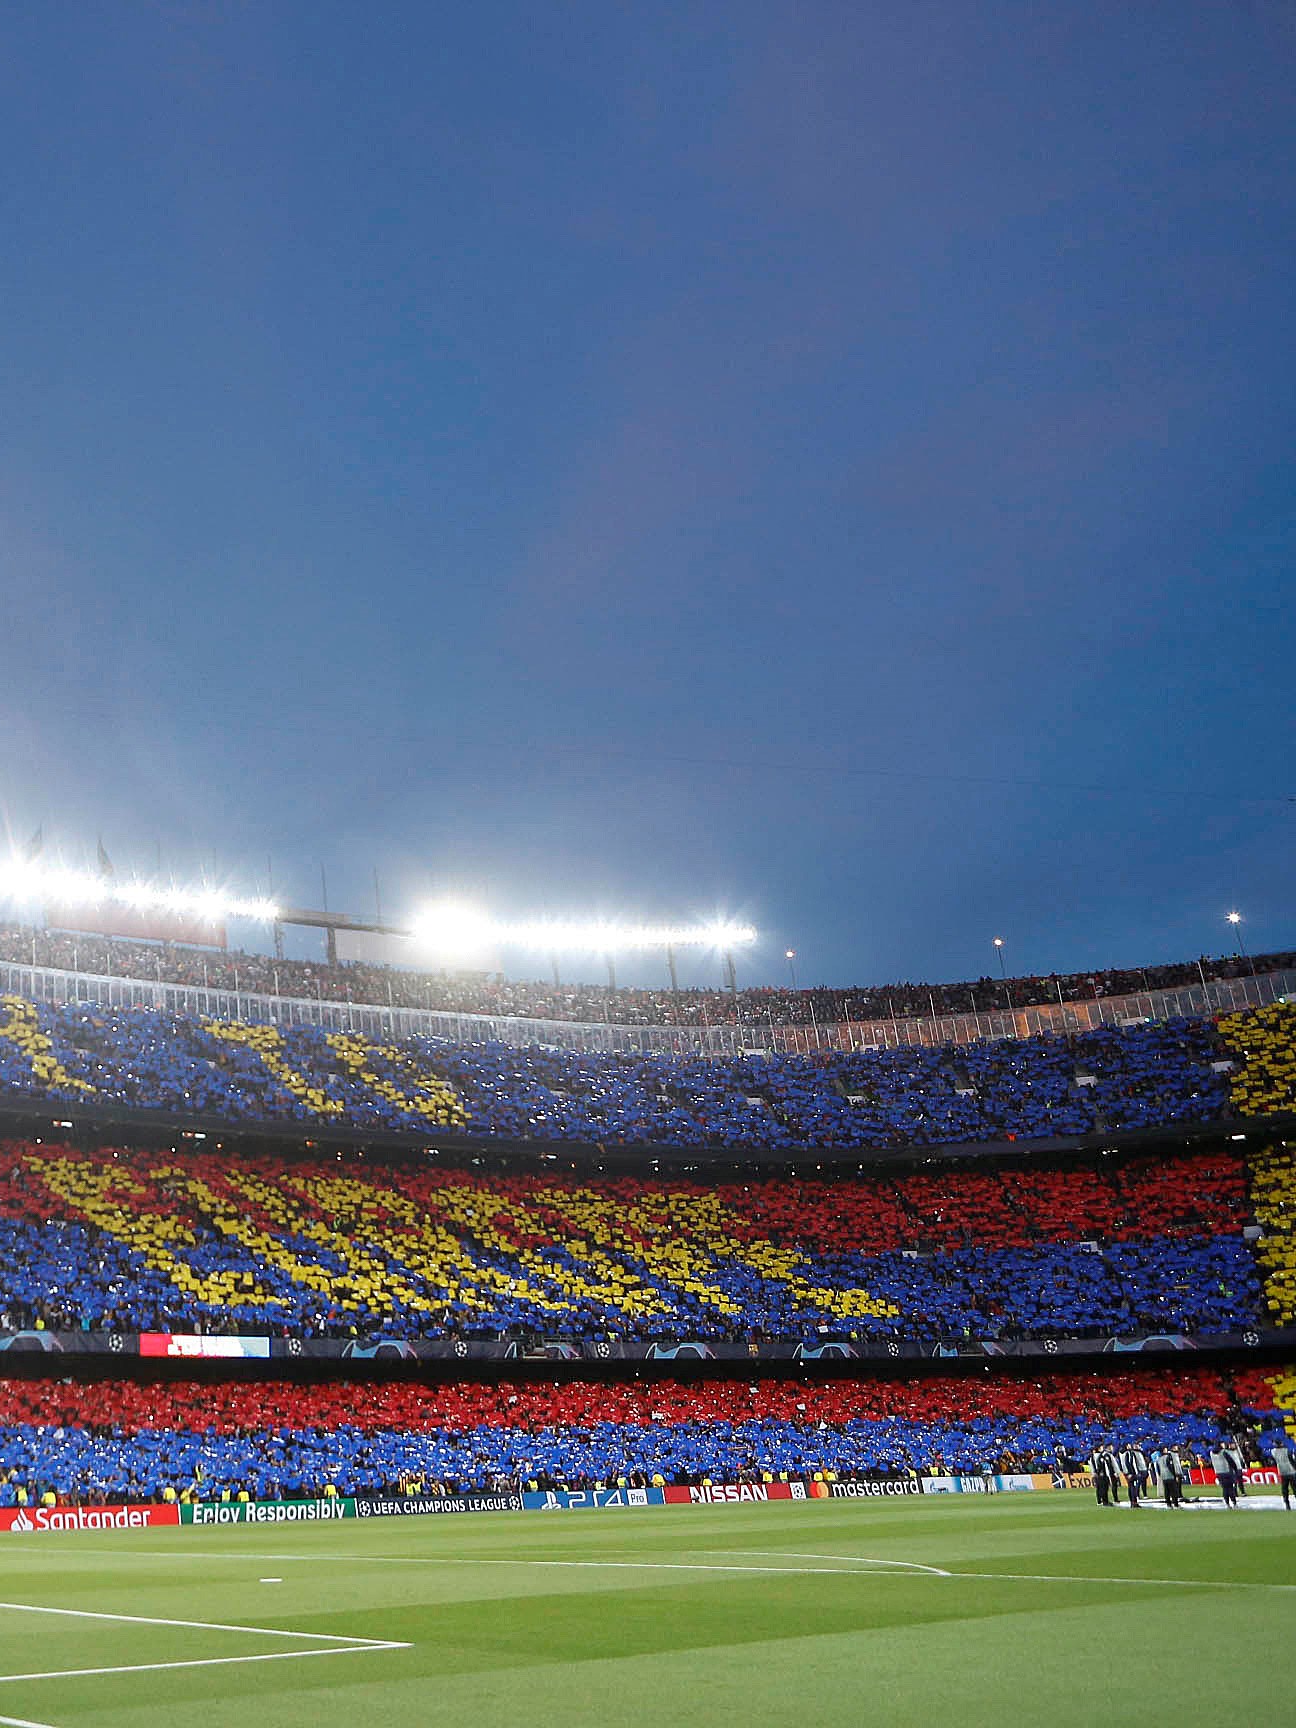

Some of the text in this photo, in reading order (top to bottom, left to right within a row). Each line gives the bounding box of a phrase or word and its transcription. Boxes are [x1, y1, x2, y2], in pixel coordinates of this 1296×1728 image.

[689, 1484, 768, 1504] NISSAN
[831, 1477, 920, 1498] mastercard
[373, 1497, 508, 1515] UEFA CHAMPIONS LEAGUE
[568, 1489, 625, 1509] PS4
[35, 1506, 151, 1531] Santander
[192, 1497, 346, 1524] Enjoy Responsibly
